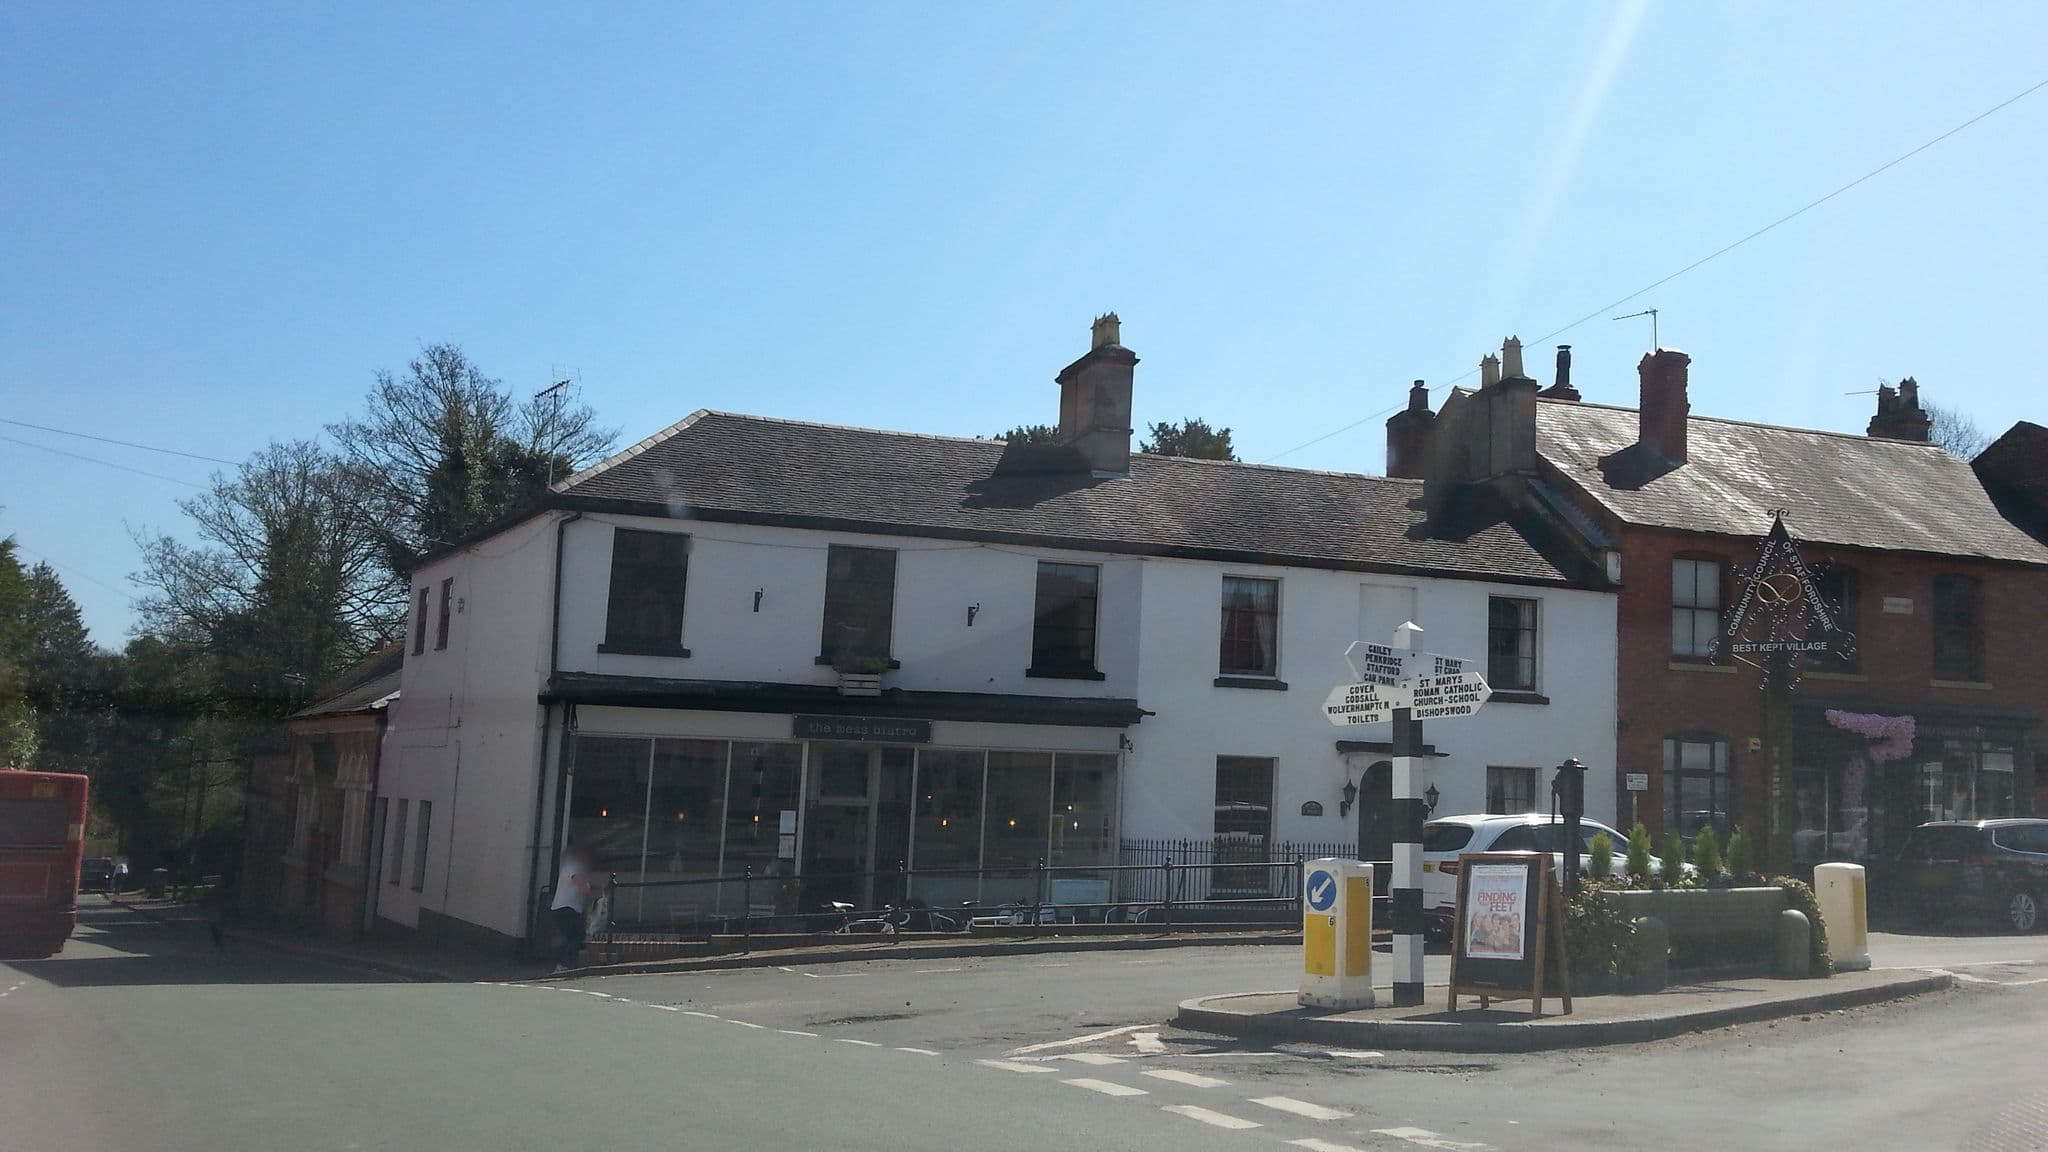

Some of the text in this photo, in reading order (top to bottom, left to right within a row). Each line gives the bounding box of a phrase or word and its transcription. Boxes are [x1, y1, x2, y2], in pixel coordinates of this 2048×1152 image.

[1782, 541, 1795, 554] OF
[1727, 539, 1777, 637] COMMUNITY COUNCIL
[1732, 642, 1828, 653] BEST KEPT VILLAGE
[1366, 654, 1402, 667] PENKRIDGE
[1366, 663, 1400, 676] STAFFORD
[1364, 673, 1396, 686] CAR PARK
[1419, 675, 1463, 688] ST MARYS
[1350, 685, 1375, 694] COVEN
[1413, 682, 1482, 698] ROMAN CATHOLIC
[1416, 705, 1472, 718] BISHOPSWOOD
[1348, 714, 1380, 724] TOILETS
[808, 722, 832, 734] the
[1478, 890, 1516, 902] FINDING
[1490, 902, 1515, 912] FEET
